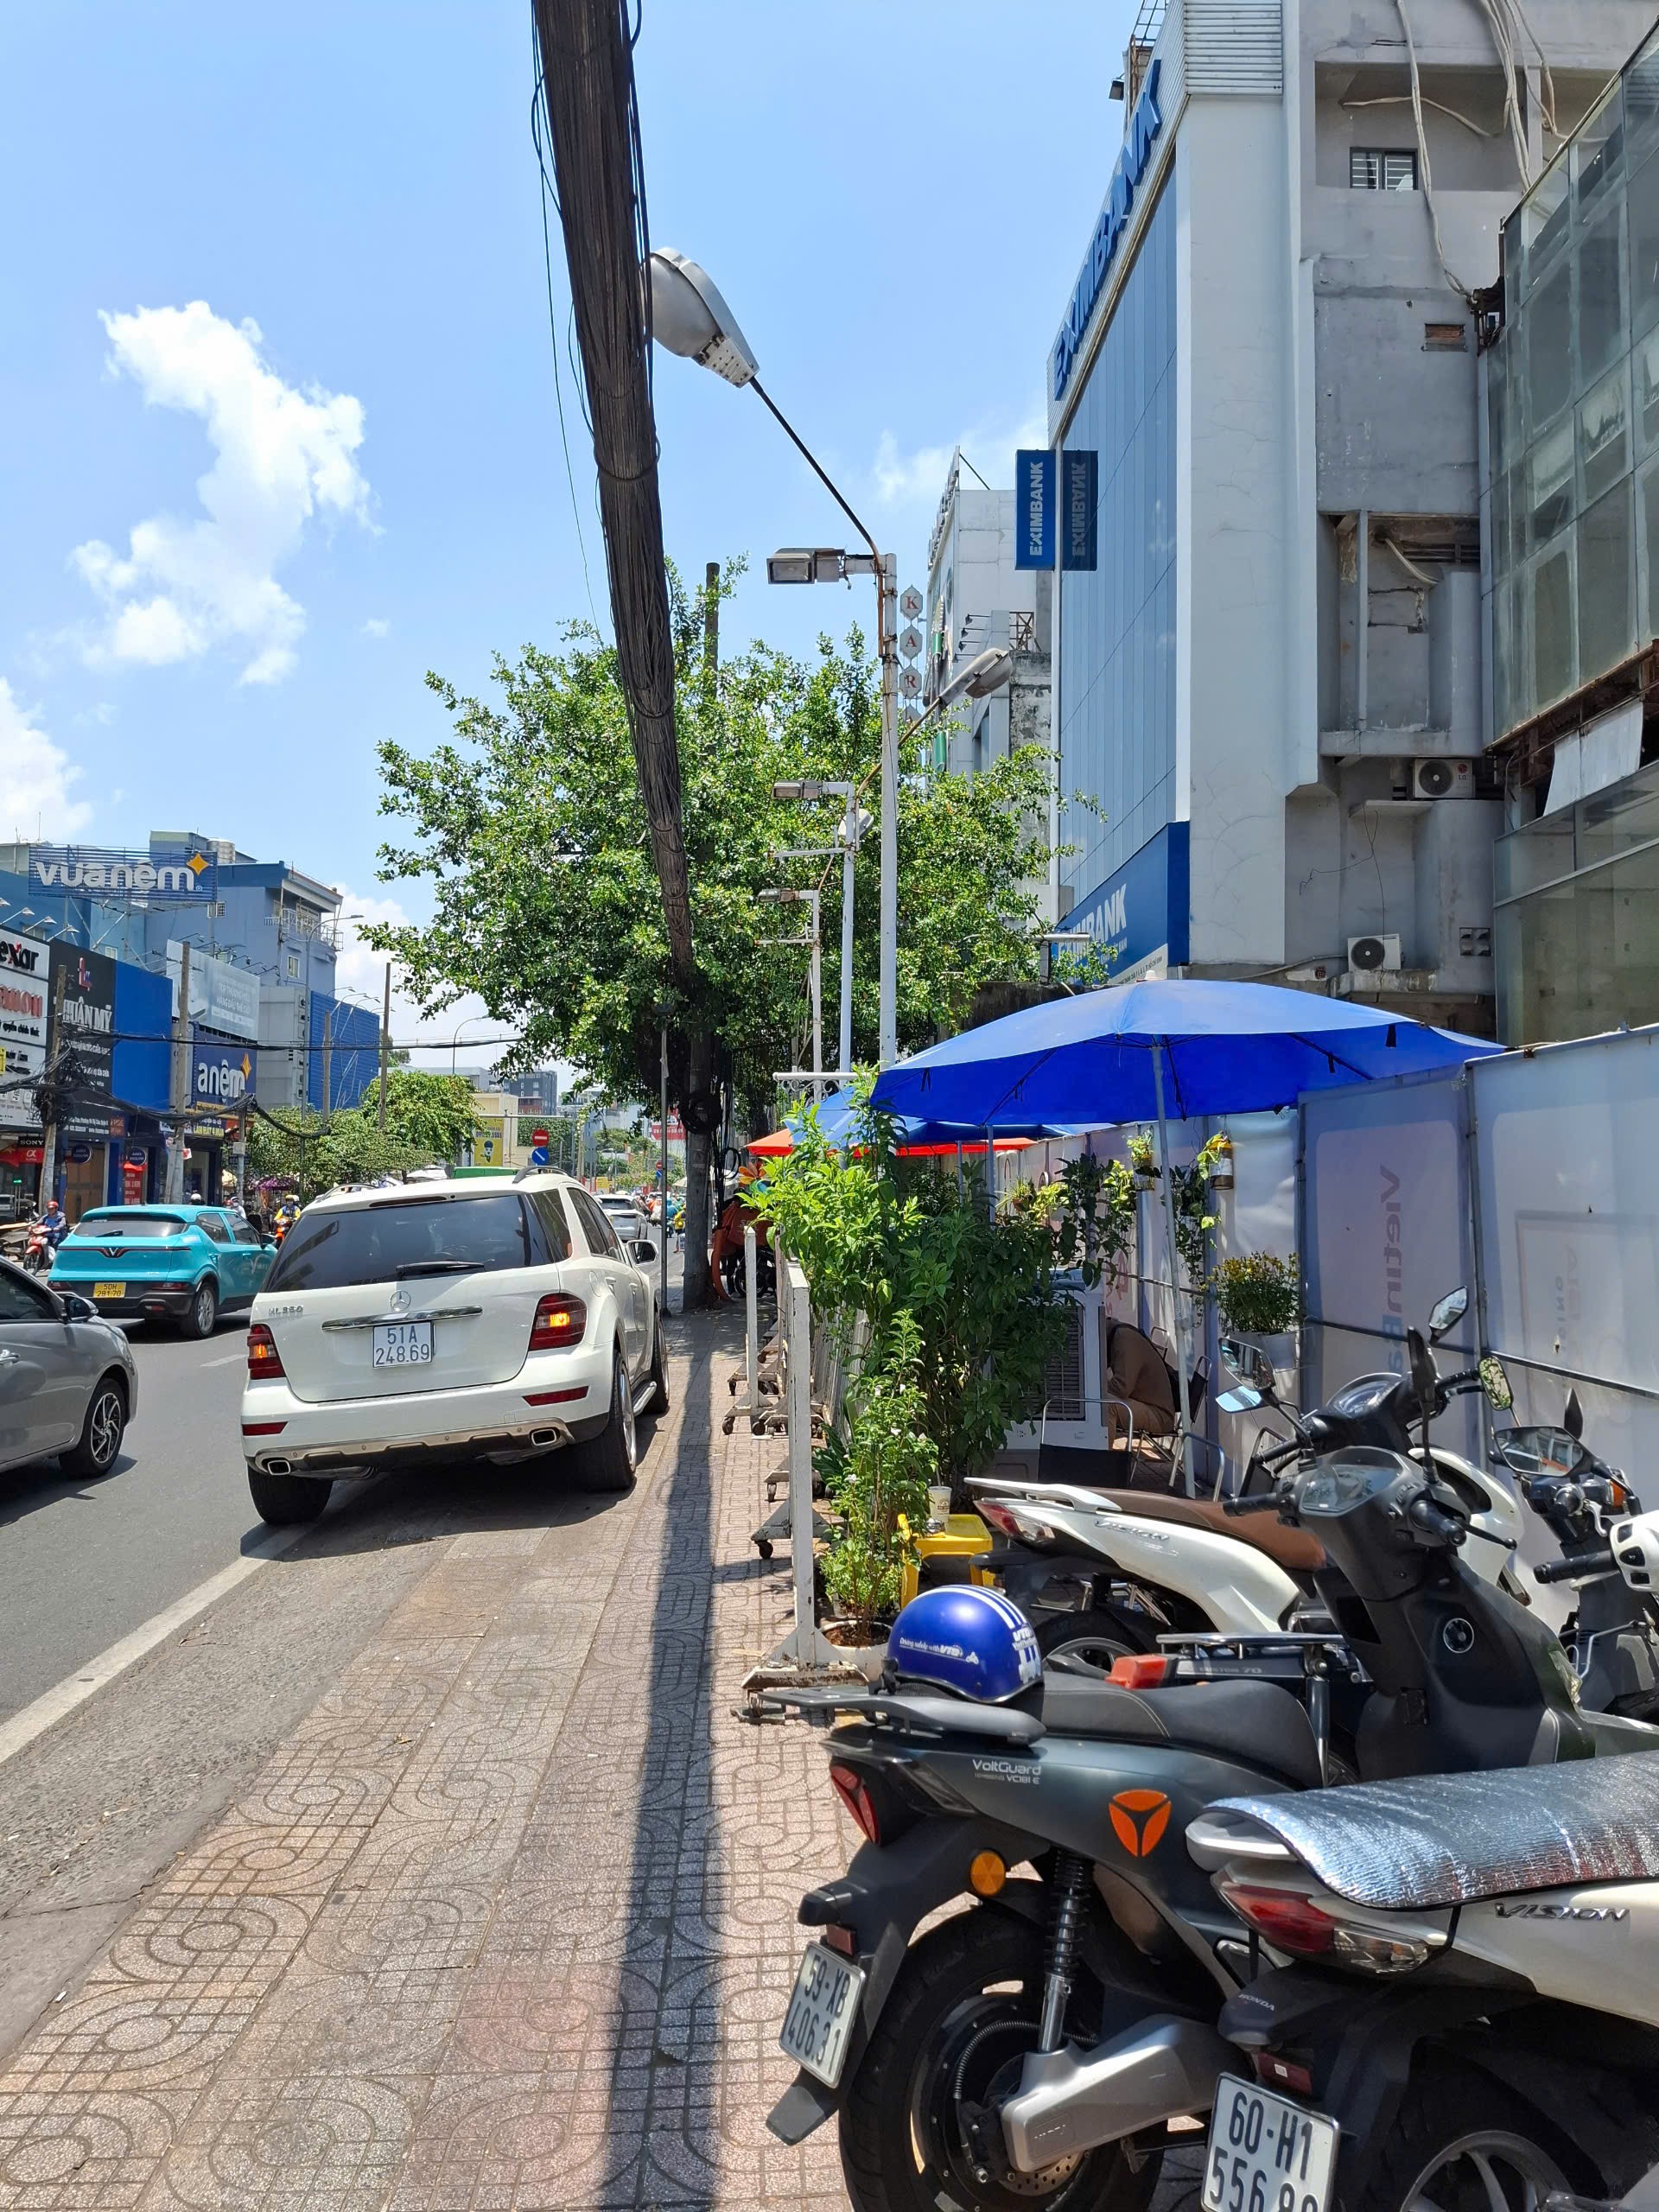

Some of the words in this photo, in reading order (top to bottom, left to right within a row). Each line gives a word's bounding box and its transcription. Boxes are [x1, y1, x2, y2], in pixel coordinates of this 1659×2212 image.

[1030, 461, 1043, 556] EXIMBANK
[387, 1325, 417, 1344] 51A
[375, 1344, 430, 1365] 248.69
[928, 1644, 940, 1653] with
[972, 1758, 1042, 1777] VoltGuard
[1495, 1903, 1631, 1922] VISION
[804, 1954, 851, 2018] 59-XB
[1237, 1993, 1274, 2012] HONDA
[787, 2000, 842, 2075] 406.31
[1229, 2091, 1313, 2181] 60-H1
